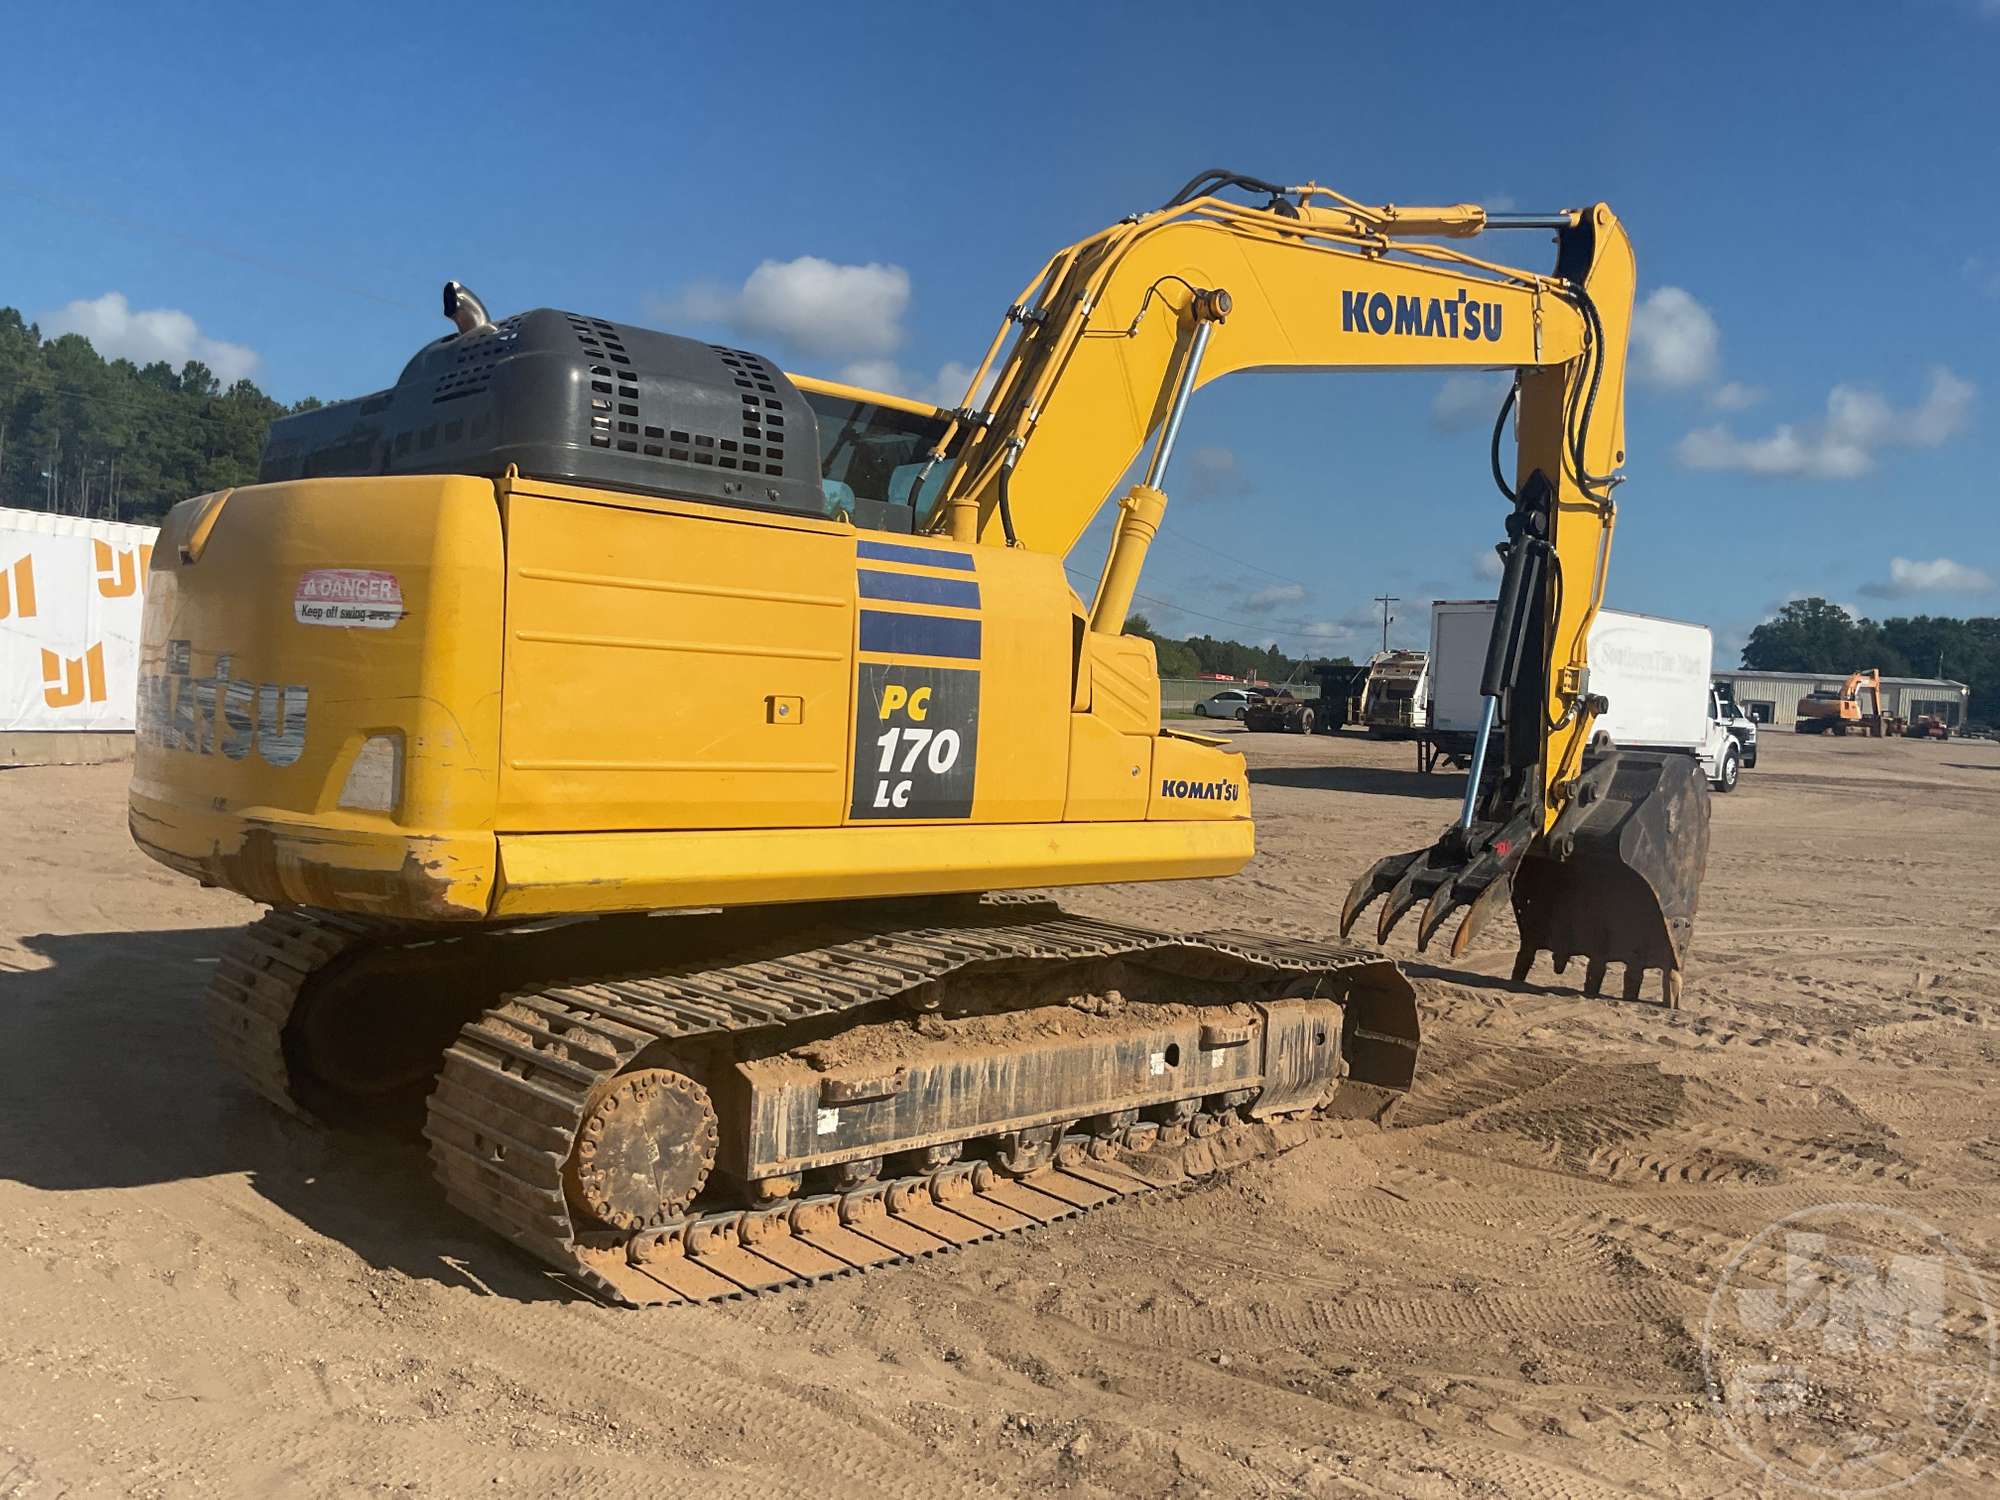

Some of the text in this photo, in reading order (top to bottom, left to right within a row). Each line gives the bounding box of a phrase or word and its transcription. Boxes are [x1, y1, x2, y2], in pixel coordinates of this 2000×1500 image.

[1342, 289, 1502, 342] KOMATSU
[320, 579, 392, 599] DANGER
[302, 604, 323, 618] Keep
[326, 606, 338, 619] off
[340, 607, 366, 621] swing
[879, 685, 932, 721] PC
[877, 728, 960, 774] 170
[873, 780, 912, 808] LC
[1162, 779, 1239, 801] KOMATSU
